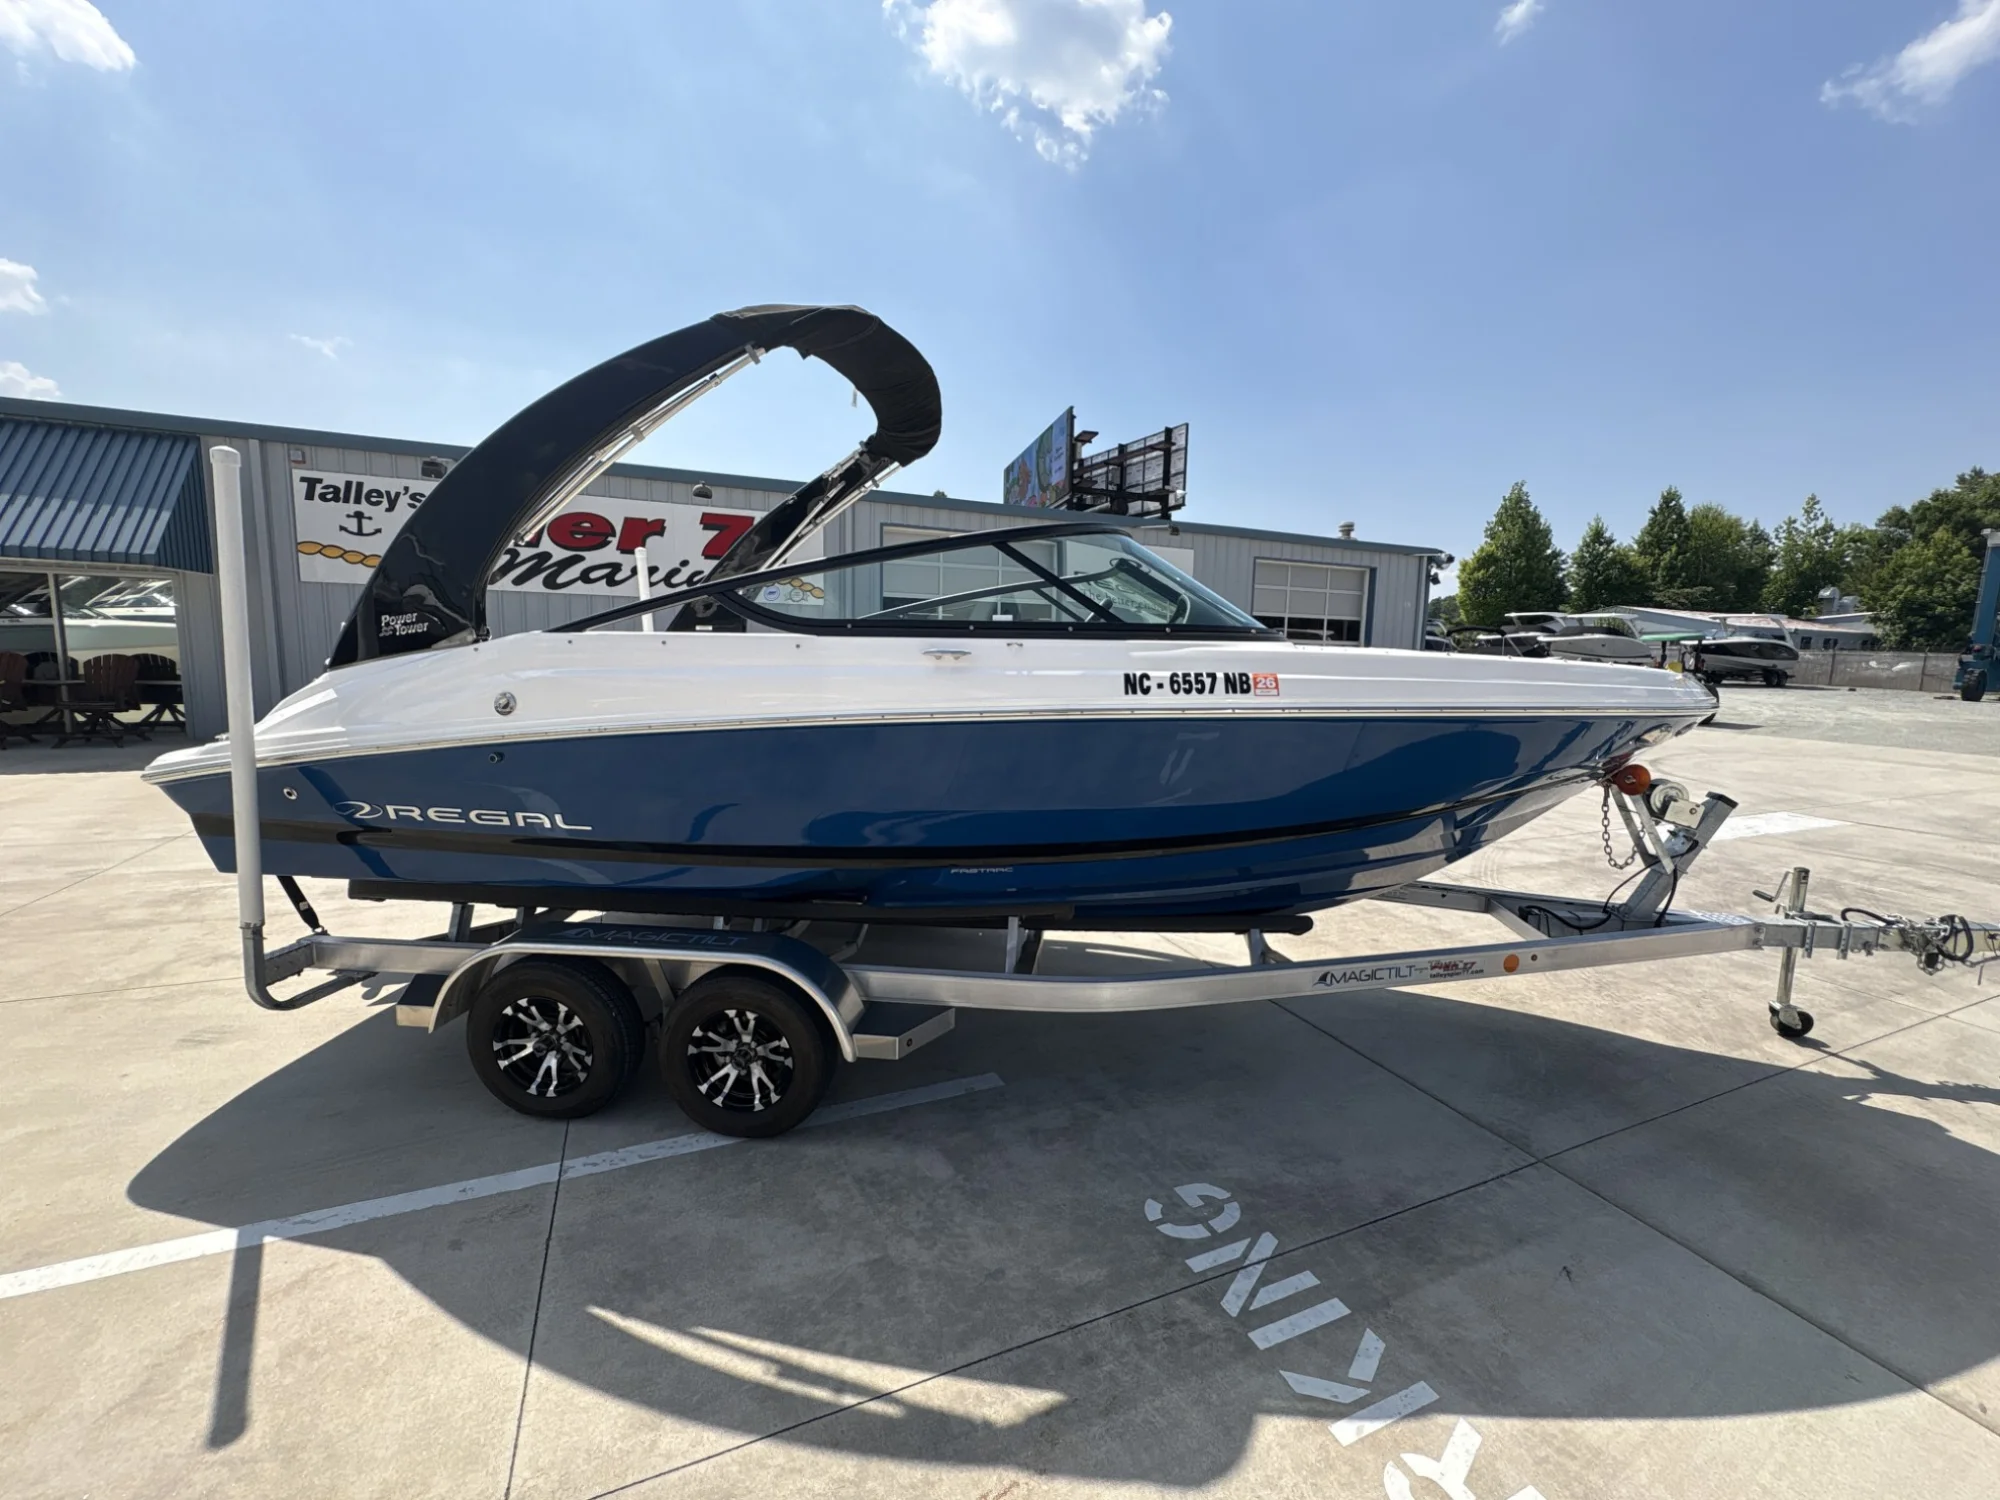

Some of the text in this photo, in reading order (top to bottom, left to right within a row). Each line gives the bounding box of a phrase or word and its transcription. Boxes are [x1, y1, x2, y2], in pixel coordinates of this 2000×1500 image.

[299, 476, 427, 513] Talley's
[515, 512, 756, 561] er 7
[381, 612, 418, 627] Power
[395, 621, 429, 636] Tower
[1123, 672, 1152, 696] NC
[1169, 672, 1218, 695] 6557
[1223, 672, 1252, 695] NB
[1256, 677, 1277, 689] 26
[385, 804, 592, 831] REGAL
[581, 927, 748, 946] MAGICTILT
[1329, 965, 1416, 986] MAGICTILT
